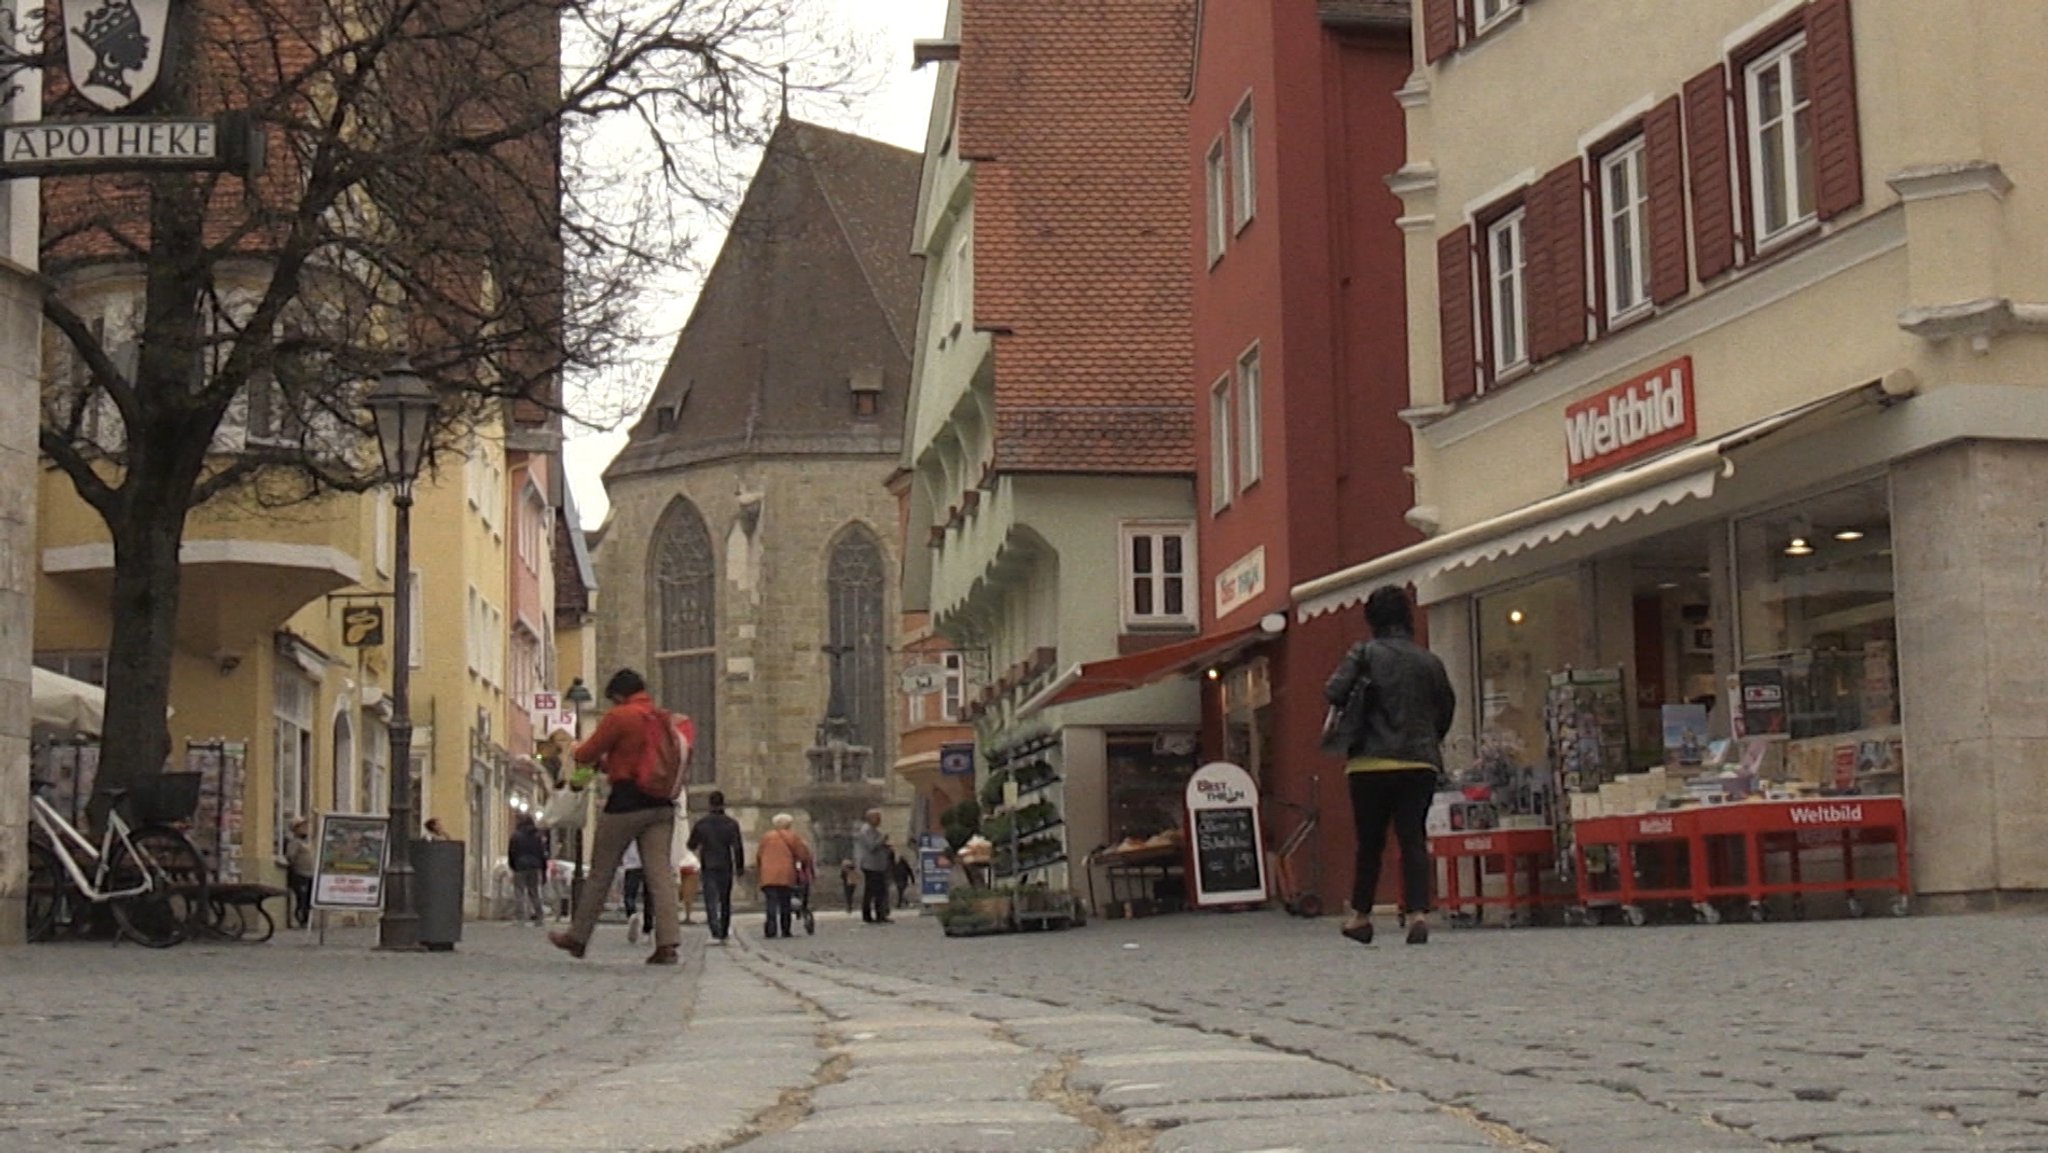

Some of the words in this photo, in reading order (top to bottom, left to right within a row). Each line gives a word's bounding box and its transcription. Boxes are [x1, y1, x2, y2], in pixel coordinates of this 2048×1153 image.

[11, 124, 210, 160] APOTHEKE
[1566, 368, 1685, 464] Weltbild
[534, 693, 557, 710] EIS
[1790, 804, 1862, 824] Weltbild
